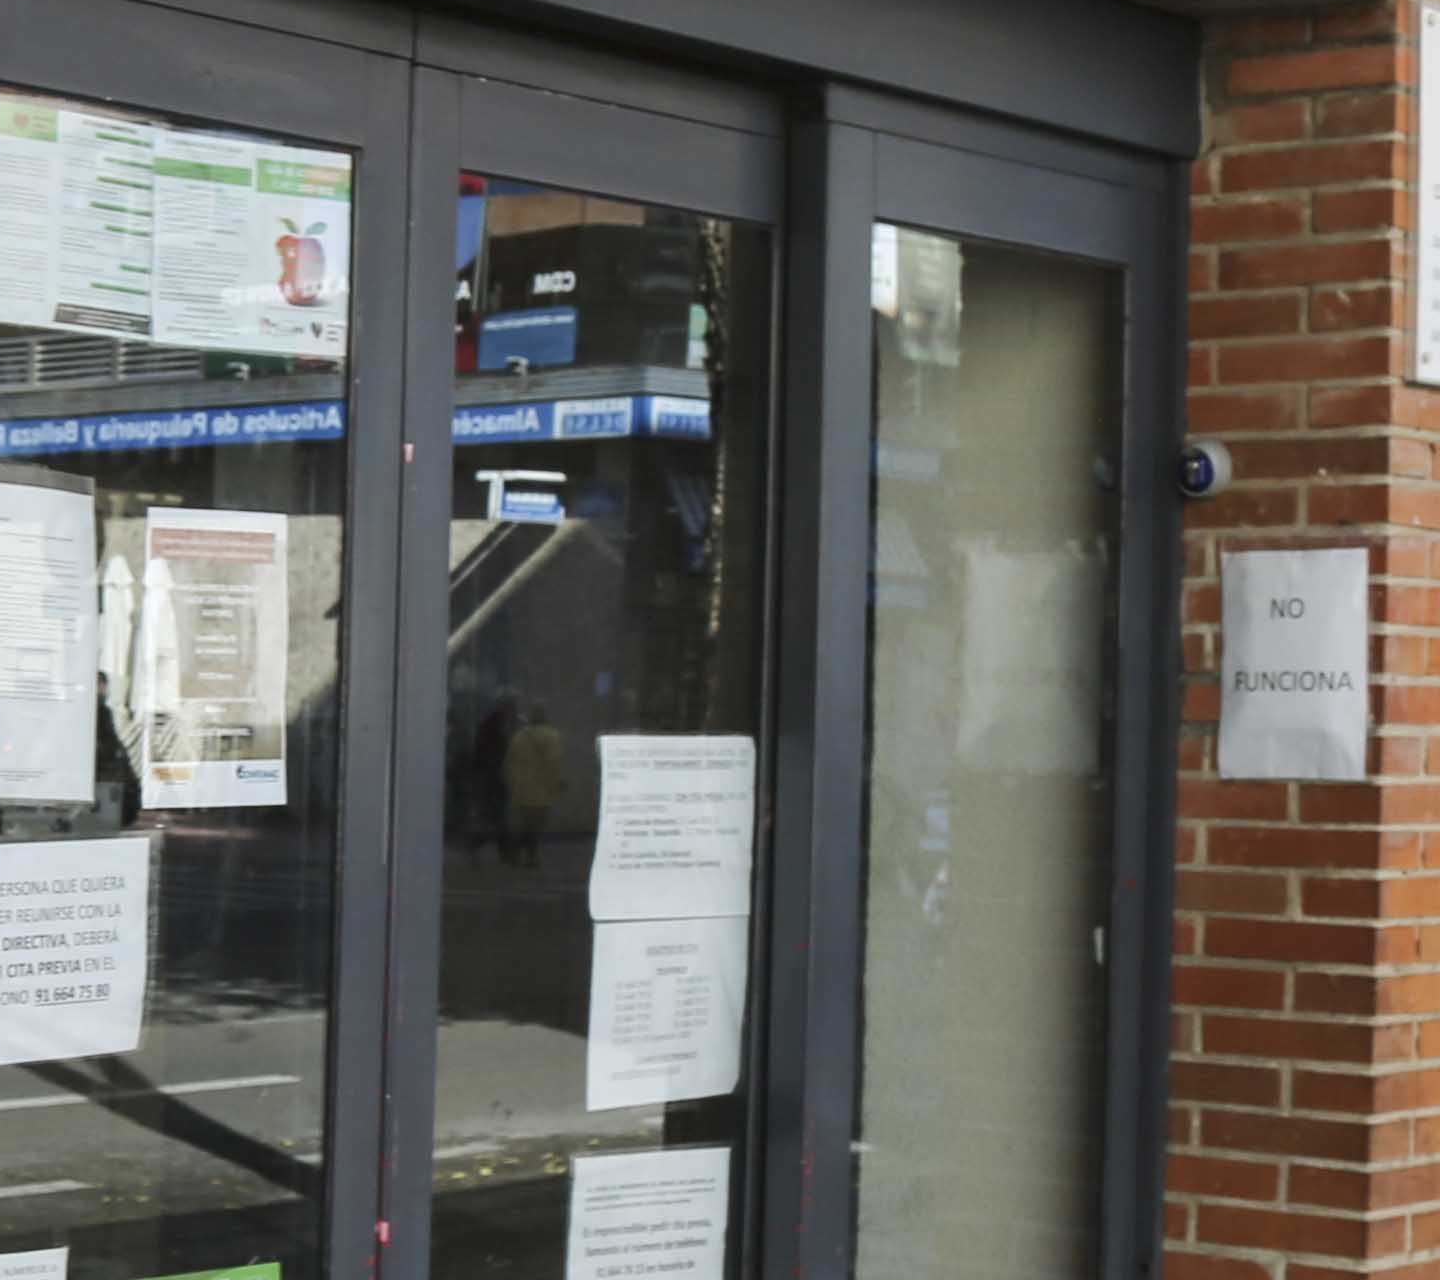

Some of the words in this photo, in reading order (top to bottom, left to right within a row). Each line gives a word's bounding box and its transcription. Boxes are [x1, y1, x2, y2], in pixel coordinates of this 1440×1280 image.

[1269, 597, 1306, 619] NO
[1234, 670, 1355, 693] FUNCIONA
[52, 878, 78, 894] QUE
[80, 875, 126, 893] QUIERA
[78, 903, 104, 920] CON
[107, 903, 122, 918] LA
[6, 962, 35, 978] CITA
[37, 959, 82, 976] PREVIA
[83, 957, 101, 973] EN
[102, 956, 117, 971] EL
[34, 987, 50, 1003] 91
